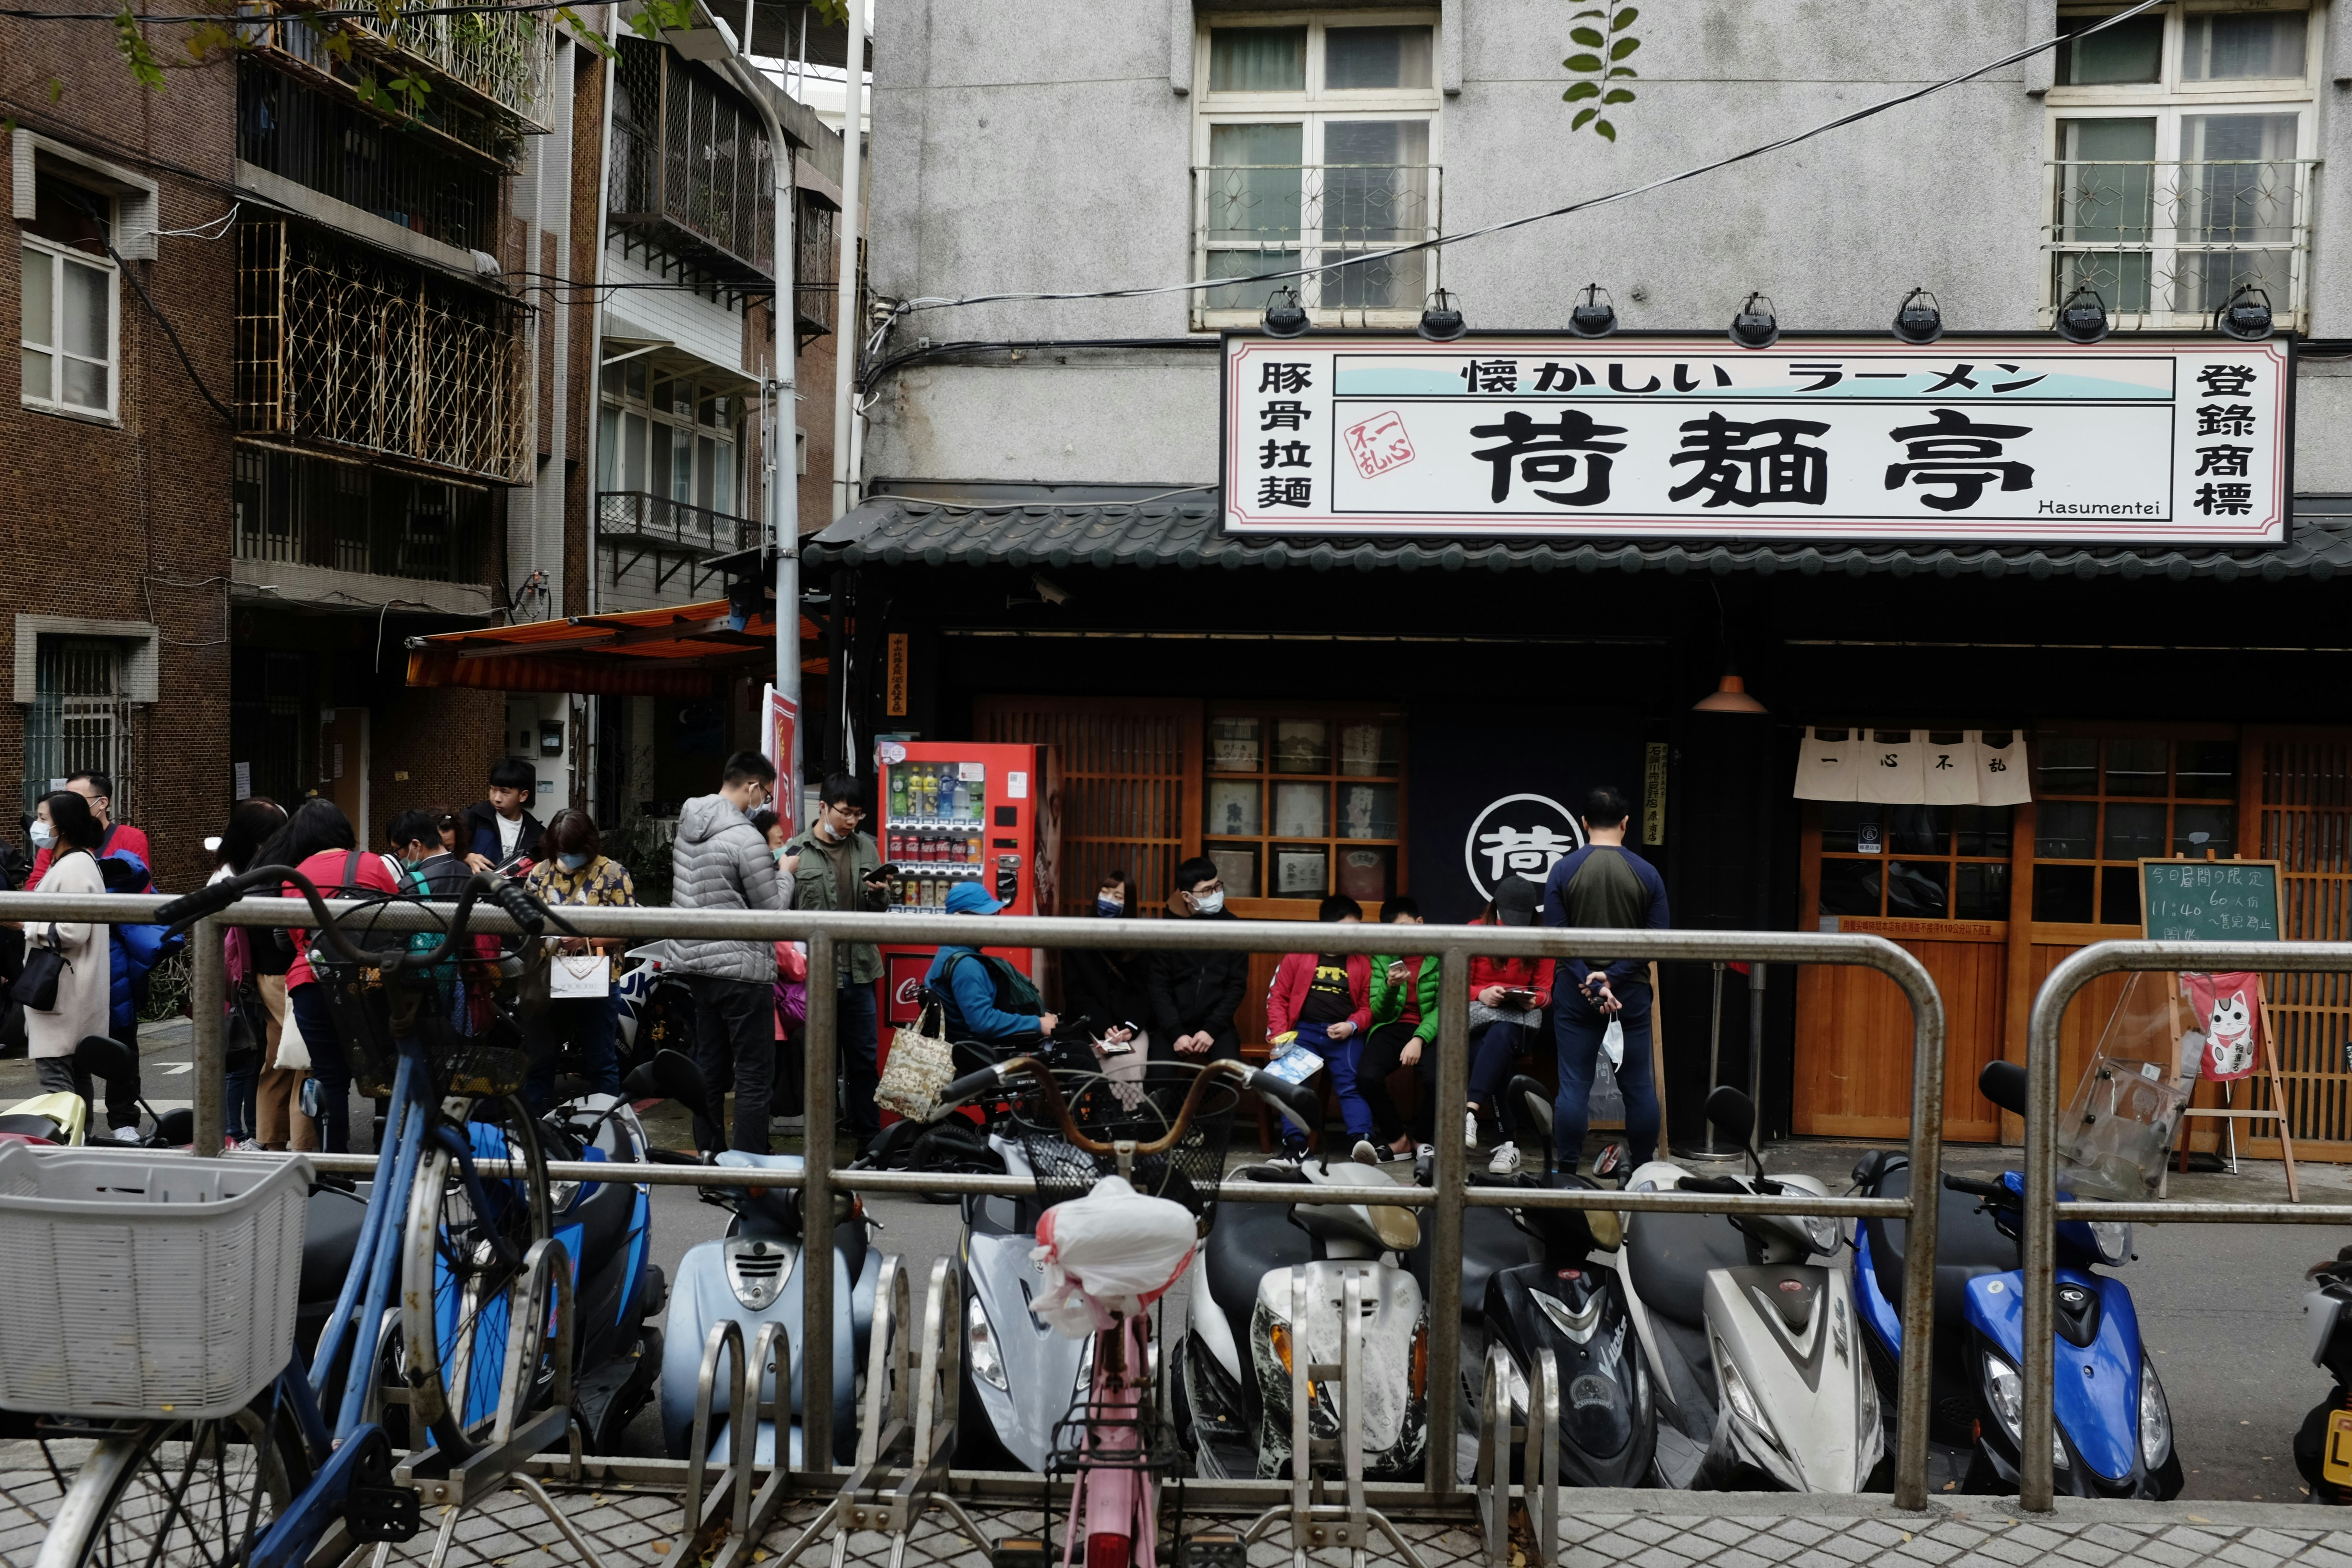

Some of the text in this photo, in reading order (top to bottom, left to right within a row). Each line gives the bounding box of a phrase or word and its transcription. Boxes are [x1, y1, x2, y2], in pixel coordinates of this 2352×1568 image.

[1460, 359, 2050, 393] 懐かしい ラーメン
[2193, 364, 2257, 516] 登錄商標
[2038, 500, 2160, 515] Hasumentei
[2152, 900, 2202, 917] 11:40
[615, 1038, 632, 1058] SUZUKI
